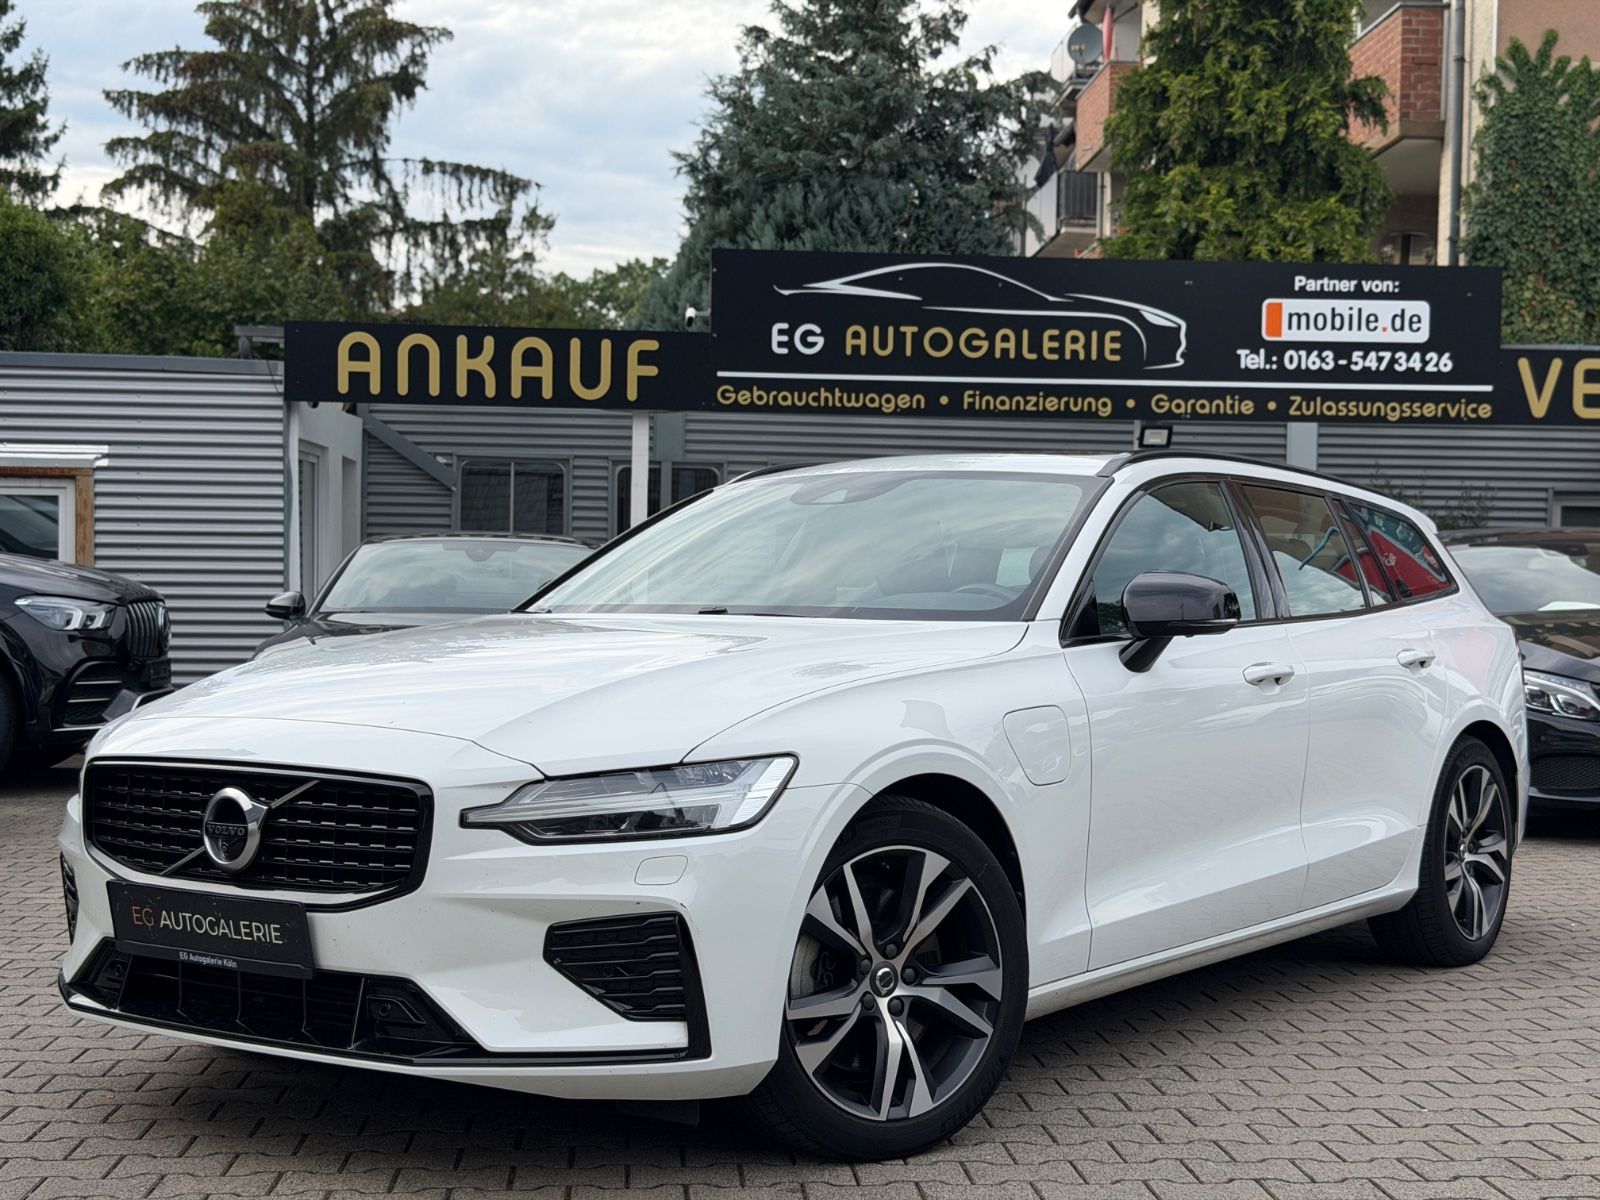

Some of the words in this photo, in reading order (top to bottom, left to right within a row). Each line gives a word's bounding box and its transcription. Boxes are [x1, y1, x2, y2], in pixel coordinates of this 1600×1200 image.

[1294, 275, 1356, 293] Partner
[1361, 278, 1400, 293] von:
[1287, 306, 1422, 334] mobile.de
[771, 323, 824, 355] EG
[845, 324, 1122, 362] AUTOGALERIE
[337, 331, 660, 402] ANKAUF
[1237, 348, 1278, 370] Tel.:
[716, 385, 925, 413] Gebrauchtwagen
[963, 390, 1112, 417] Finanzierung
[1151, 394, 1255, 415] Garantie
[1288, 396, 1493, 422] Zulassungsservice
[206, 824, 245, 836] VOLVO
[132, 906, 155, 927] EG
[159, 910, 283, 944] AUTOGALERIE
[179, 951, 189, 960] EG
[189, 953, 223, 966] Autogalerie
